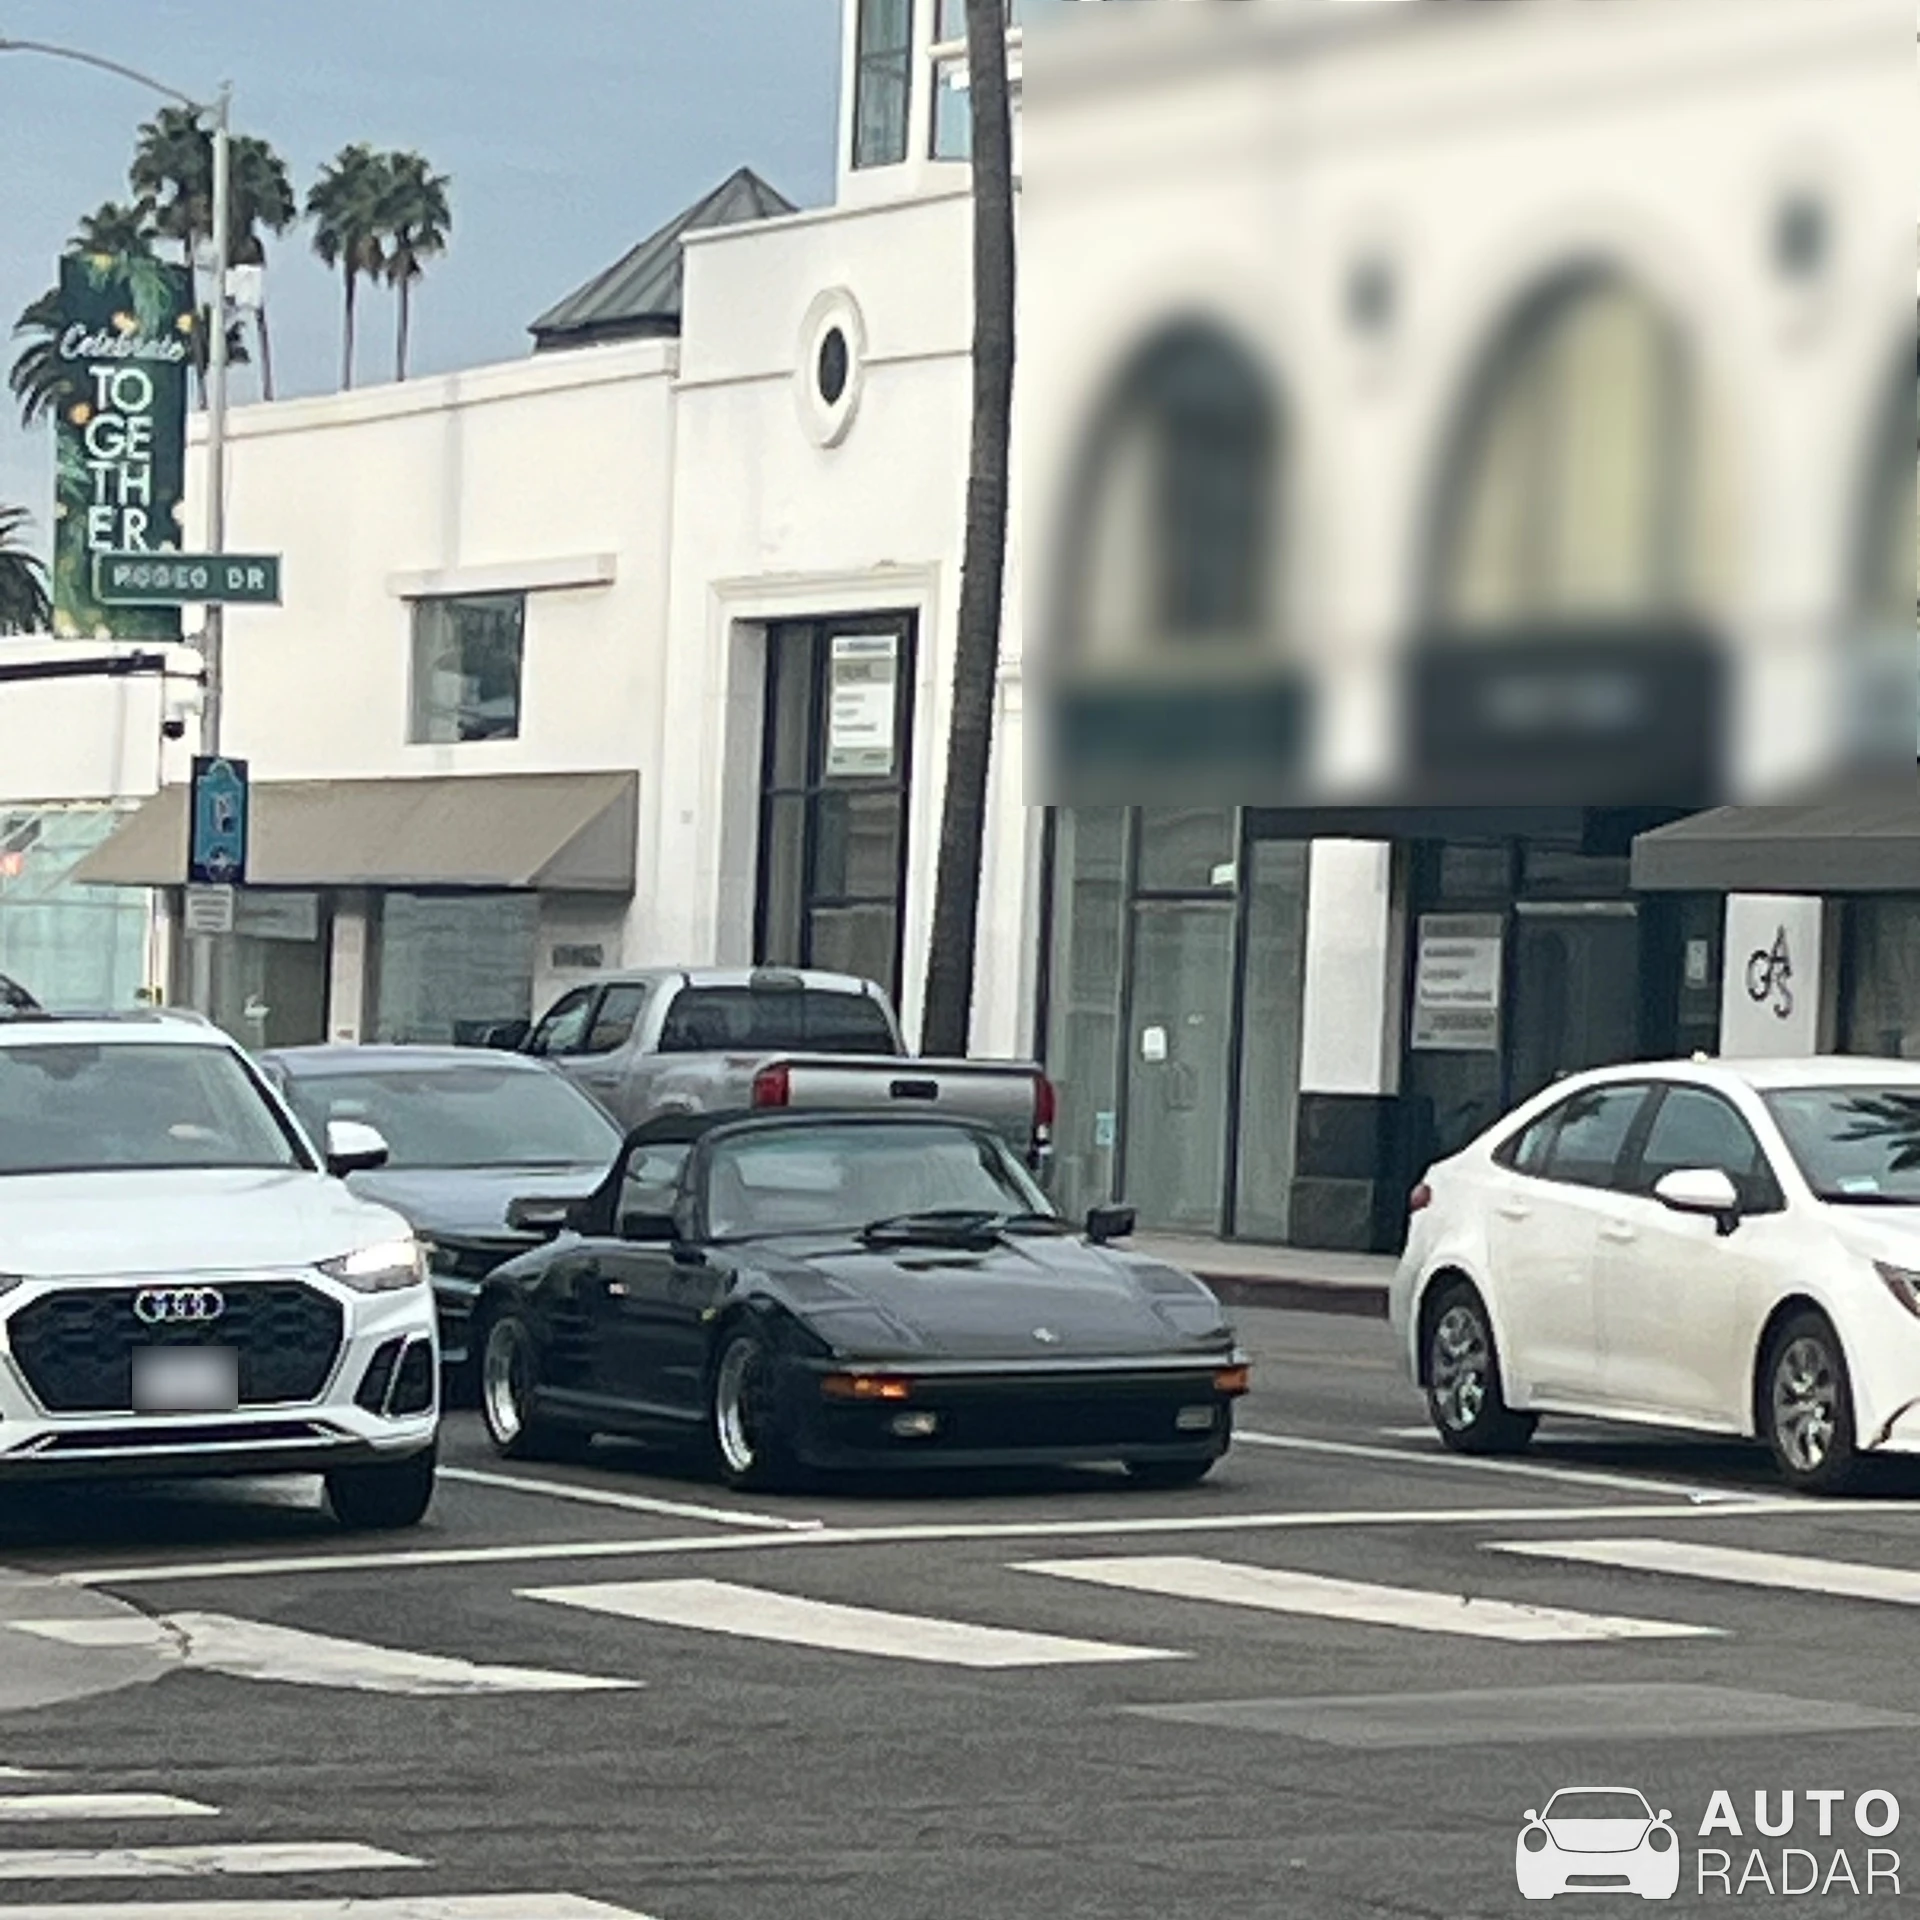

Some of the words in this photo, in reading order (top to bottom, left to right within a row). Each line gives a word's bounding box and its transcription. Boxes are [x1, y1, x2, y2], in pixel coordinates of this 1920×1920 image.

[88, 366, 154, 412] TO
[85, 414, 153, 462] GE
[87, 461, 151, 506] TH
[87, 505, 148, 552] ER
[113, 563, 208, 590] RODEO
[226, 566, 265, 590] DR
